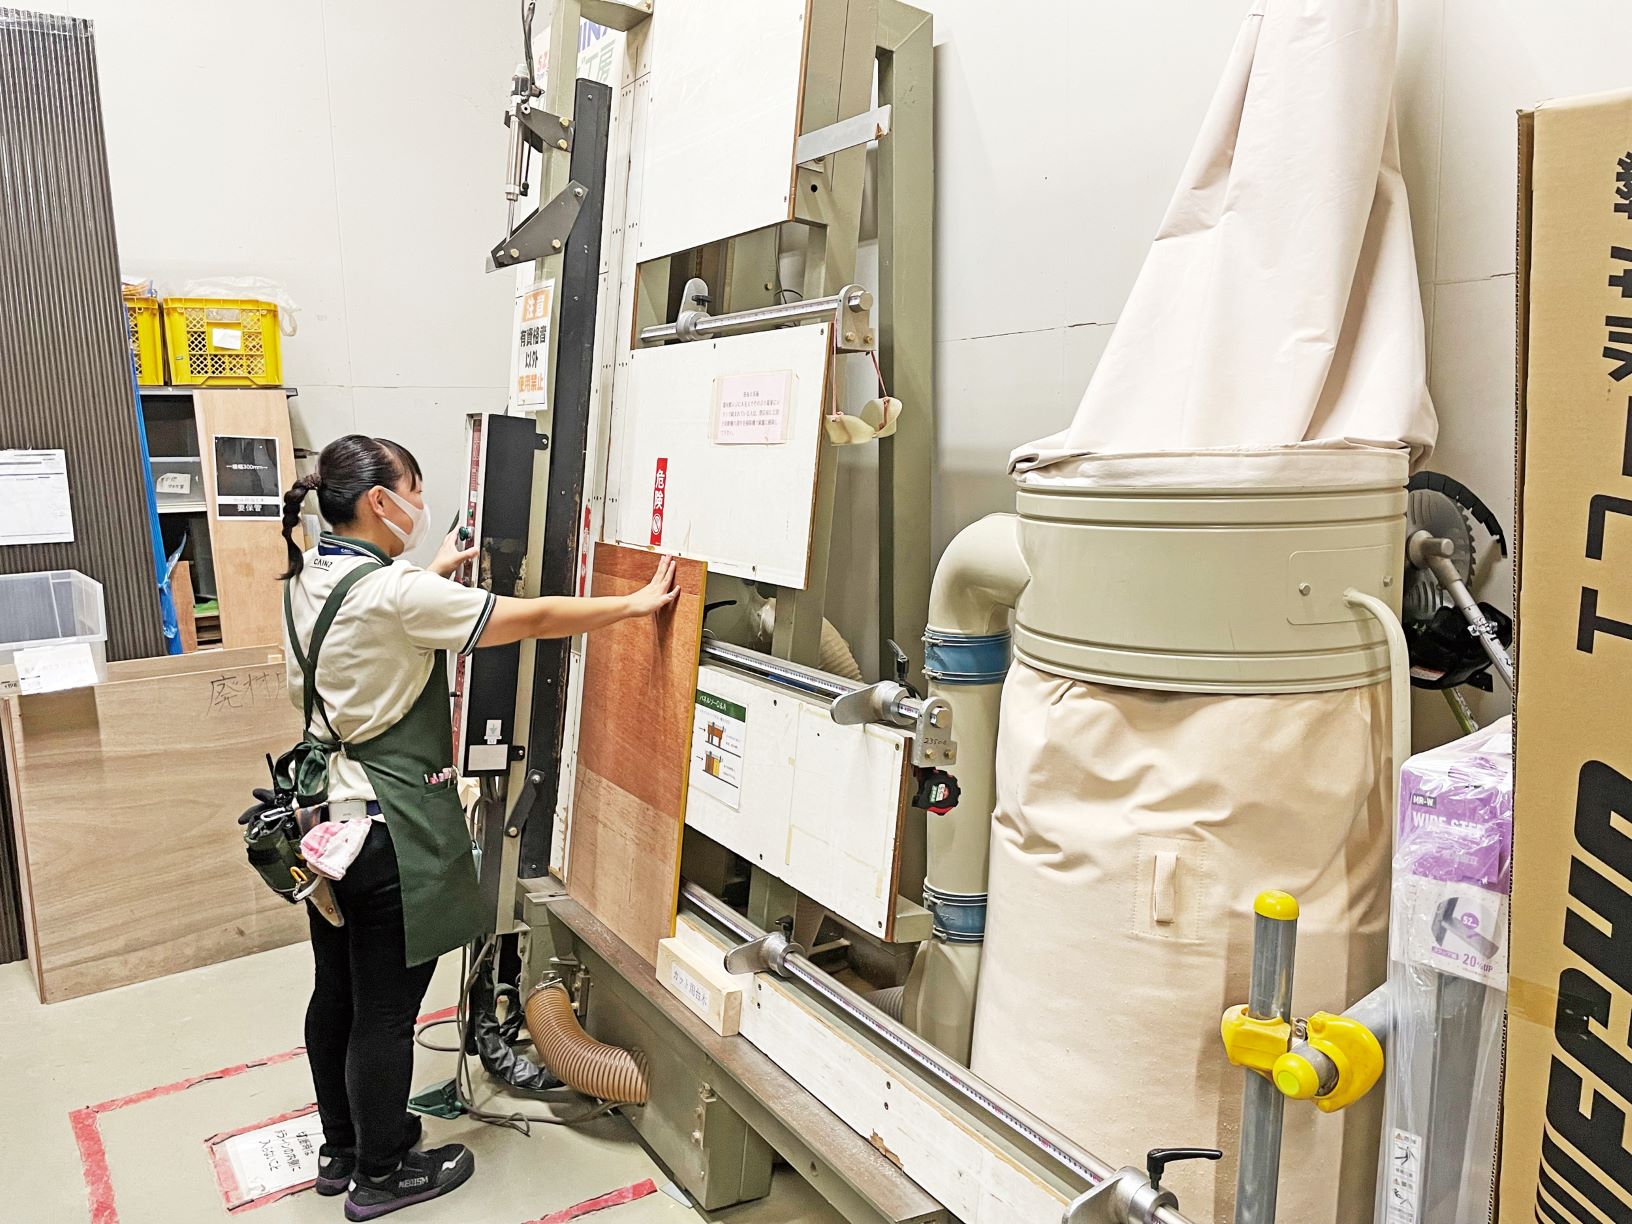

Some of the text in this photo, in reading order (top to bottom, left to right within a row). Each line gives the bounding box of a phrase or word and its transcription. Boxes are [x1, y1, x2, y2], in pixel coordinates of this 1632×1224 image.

[520, 325, 547, 348] 有資格者
[525, 349, 539, 369] 以外
[518, 371, 545, 393] 使用禁止
[654, 468, 666, 510] 危険
[313, 558, 334, 568] CAINZ
[1413, 795, 1434, 807] MR-W
